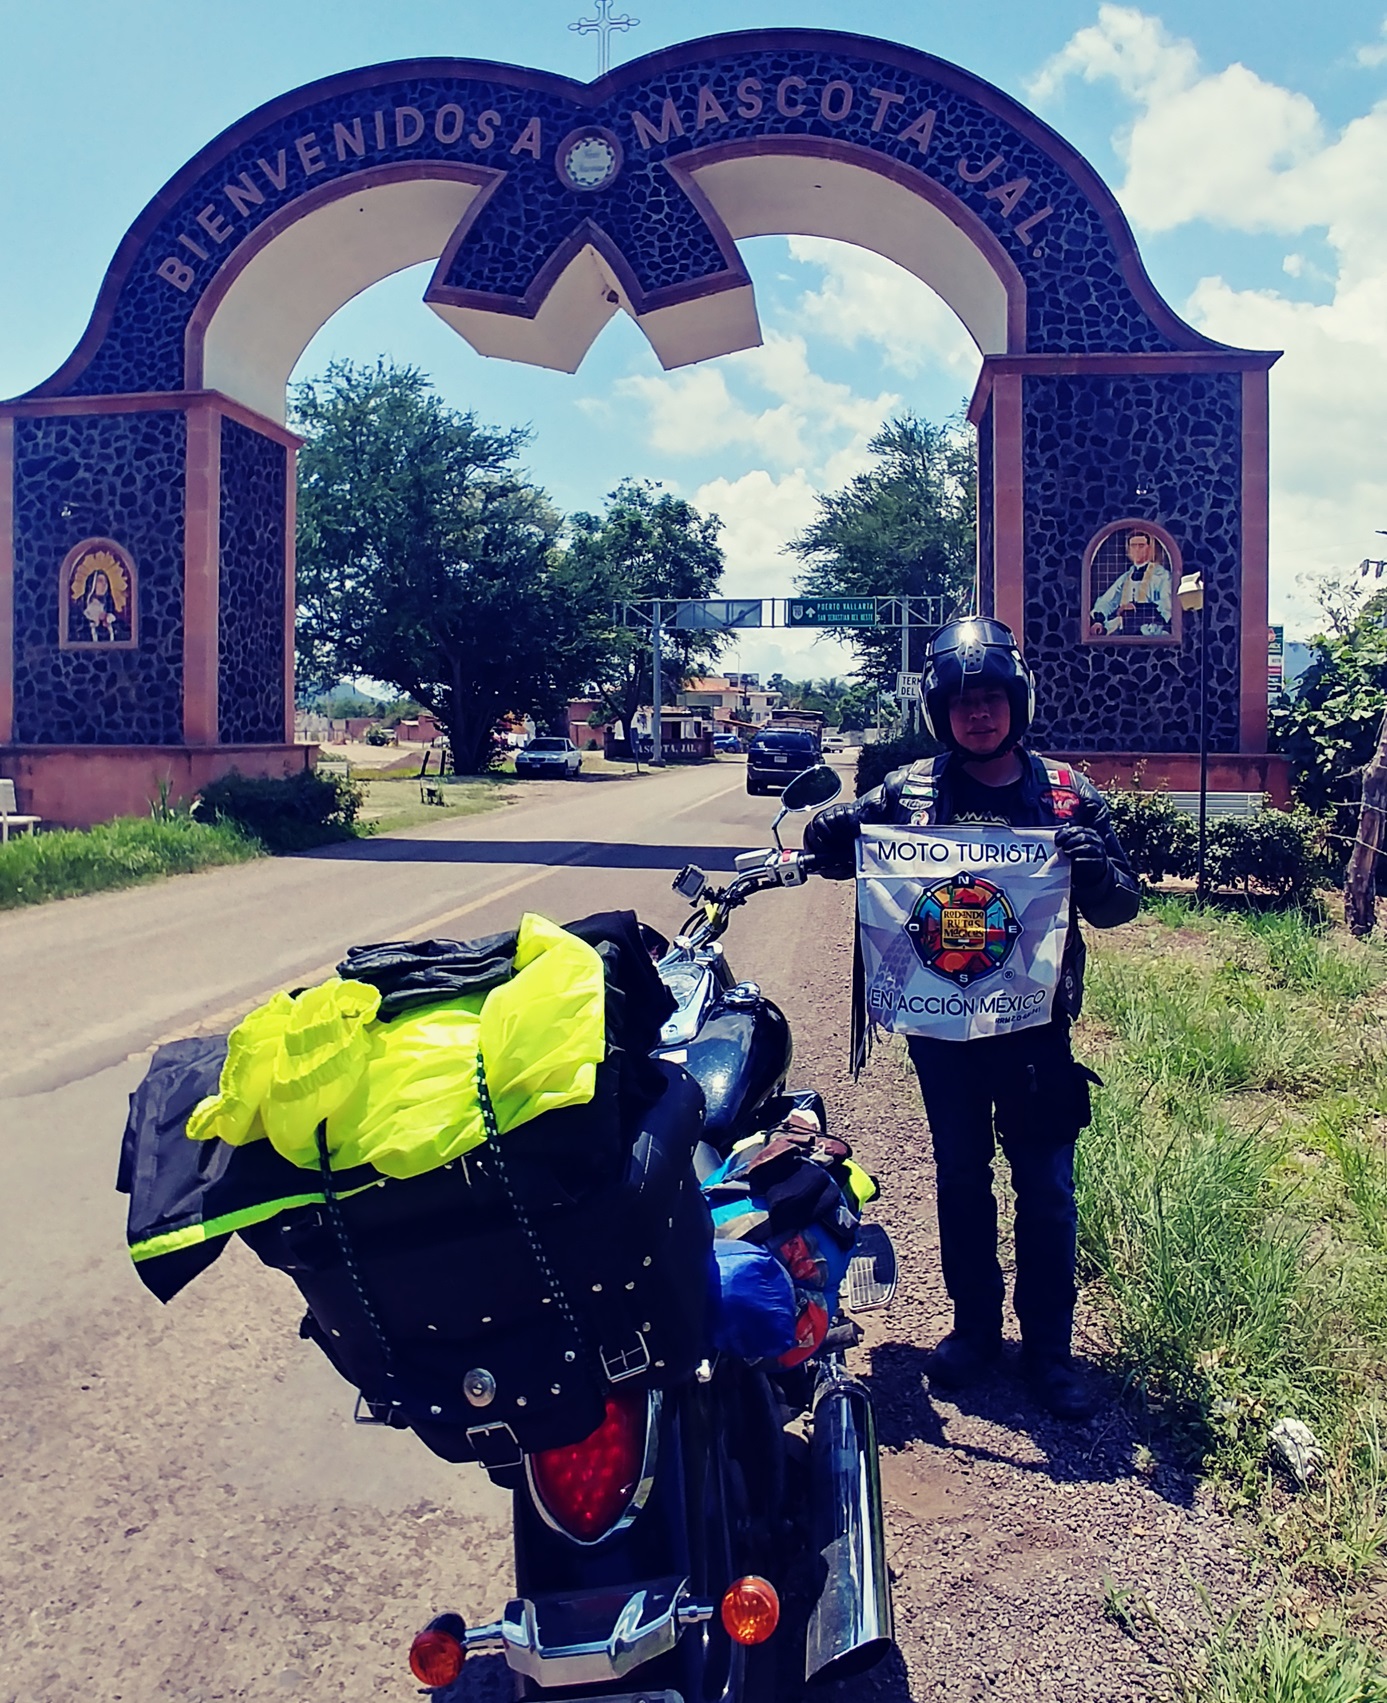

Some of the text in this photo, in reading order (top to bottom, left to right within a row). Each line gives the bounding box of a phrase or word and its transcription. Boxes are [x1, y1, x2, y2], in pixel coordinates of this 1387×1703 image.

[155, 102, 501, 293] BIENVENIDOS
[509, 116, 544, 161] A
[631, 75, 938, 156] MASCOTA
[817, 602, 873, 610] PUERTO VALLARTA
[817, 613, 826, 621] SAN
[901, 686, 916, 696] DEL
[877, 841, 1049, 864] MOTO TURISTA
[958, 875, 970, 884] N
[1008, 925, 1018, 933] E
[959, 974, 969, 983] S
[870, 988, 894, 1009] EN
[897, 993, 975, 1016] ACCIÓN
[979, 989, 1046, 1014] MÉXICO
